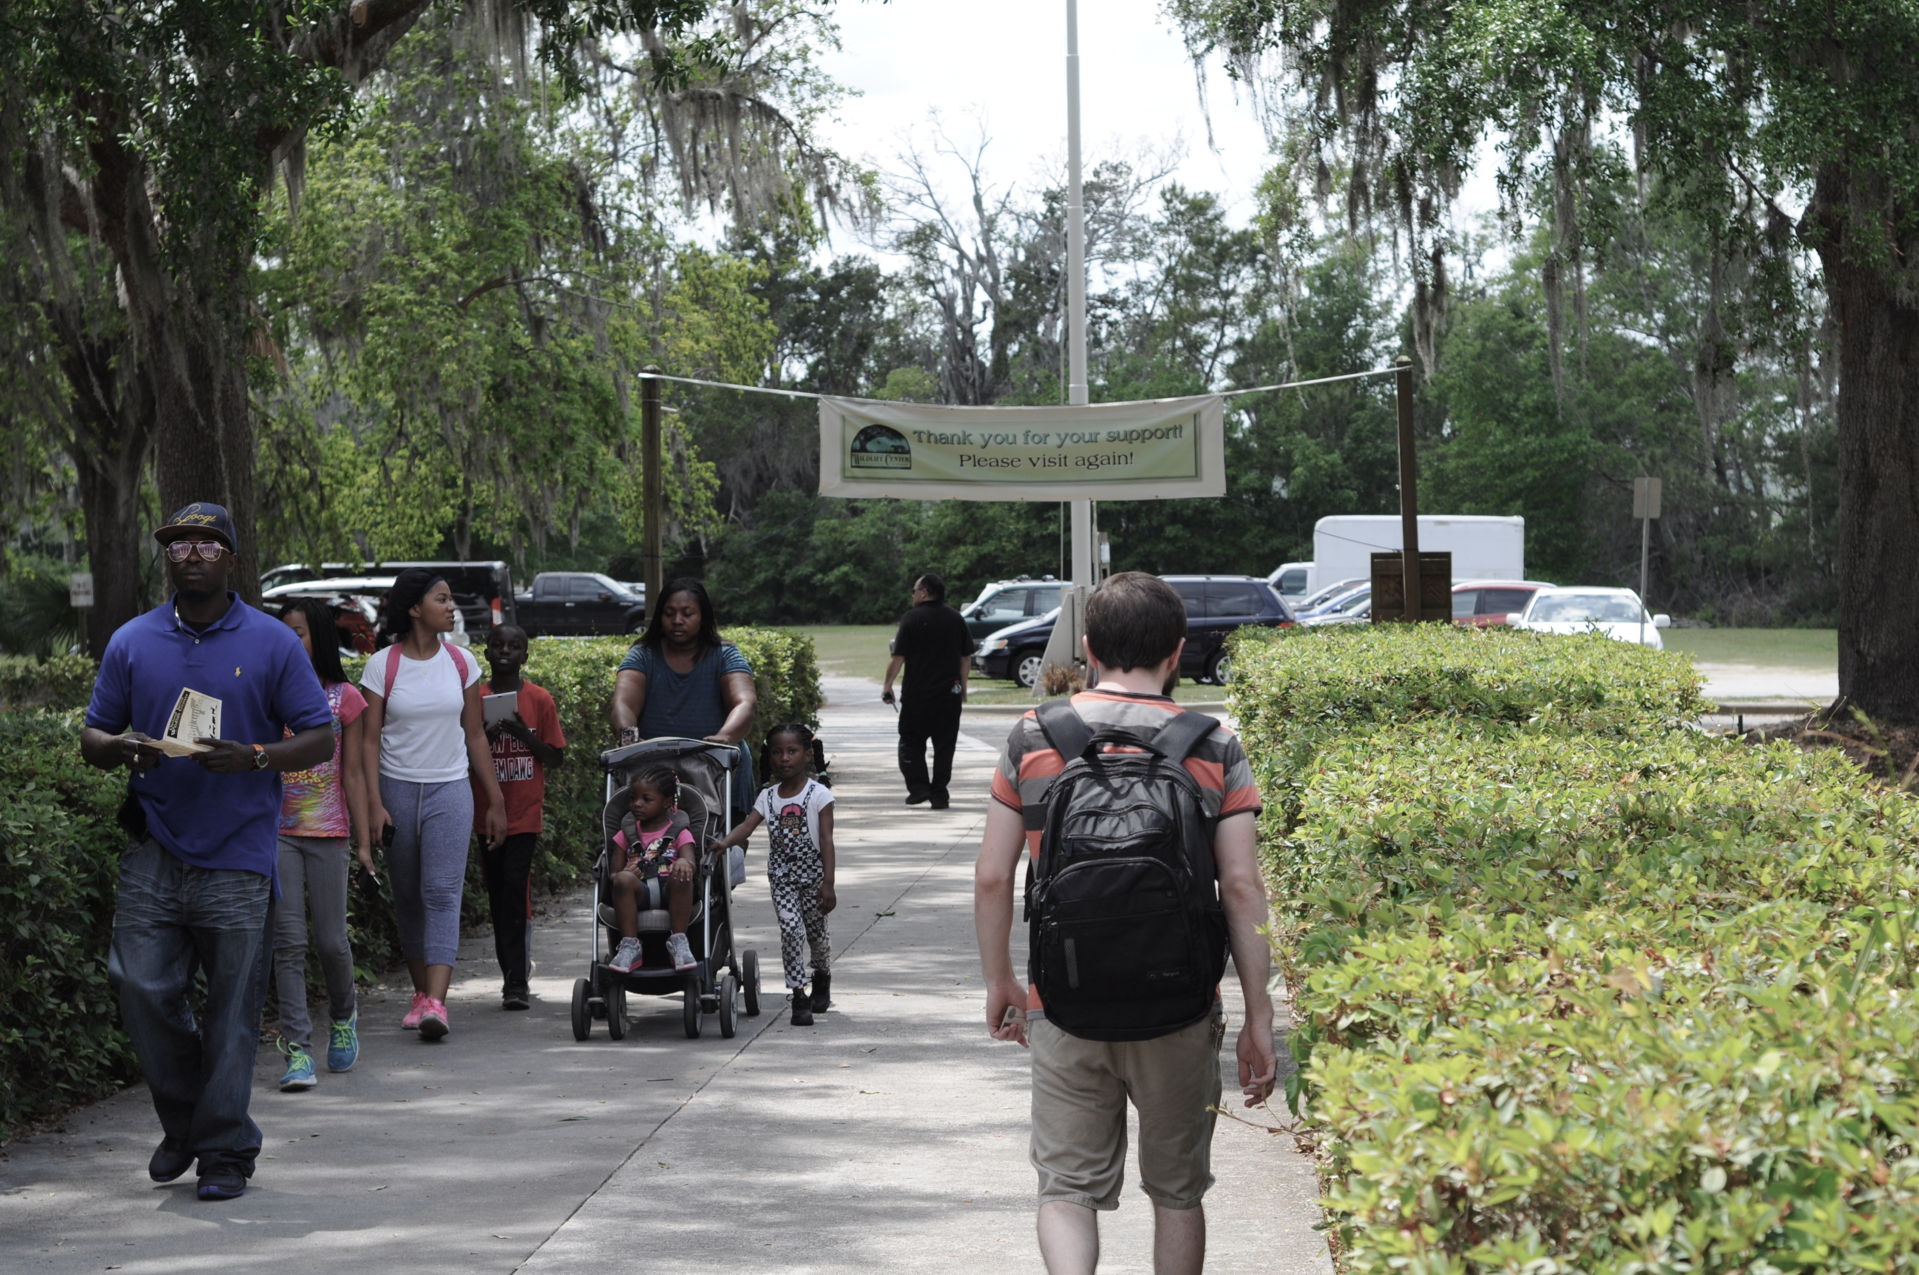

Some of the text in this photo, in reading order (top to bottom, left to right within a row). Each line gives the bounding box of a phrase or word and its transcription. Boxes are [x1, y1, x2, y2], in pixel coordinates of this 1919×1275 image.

[912, 424, 1183, 449] Thank you for your support!
[959, 451, 1134, 470] Please visit again!
